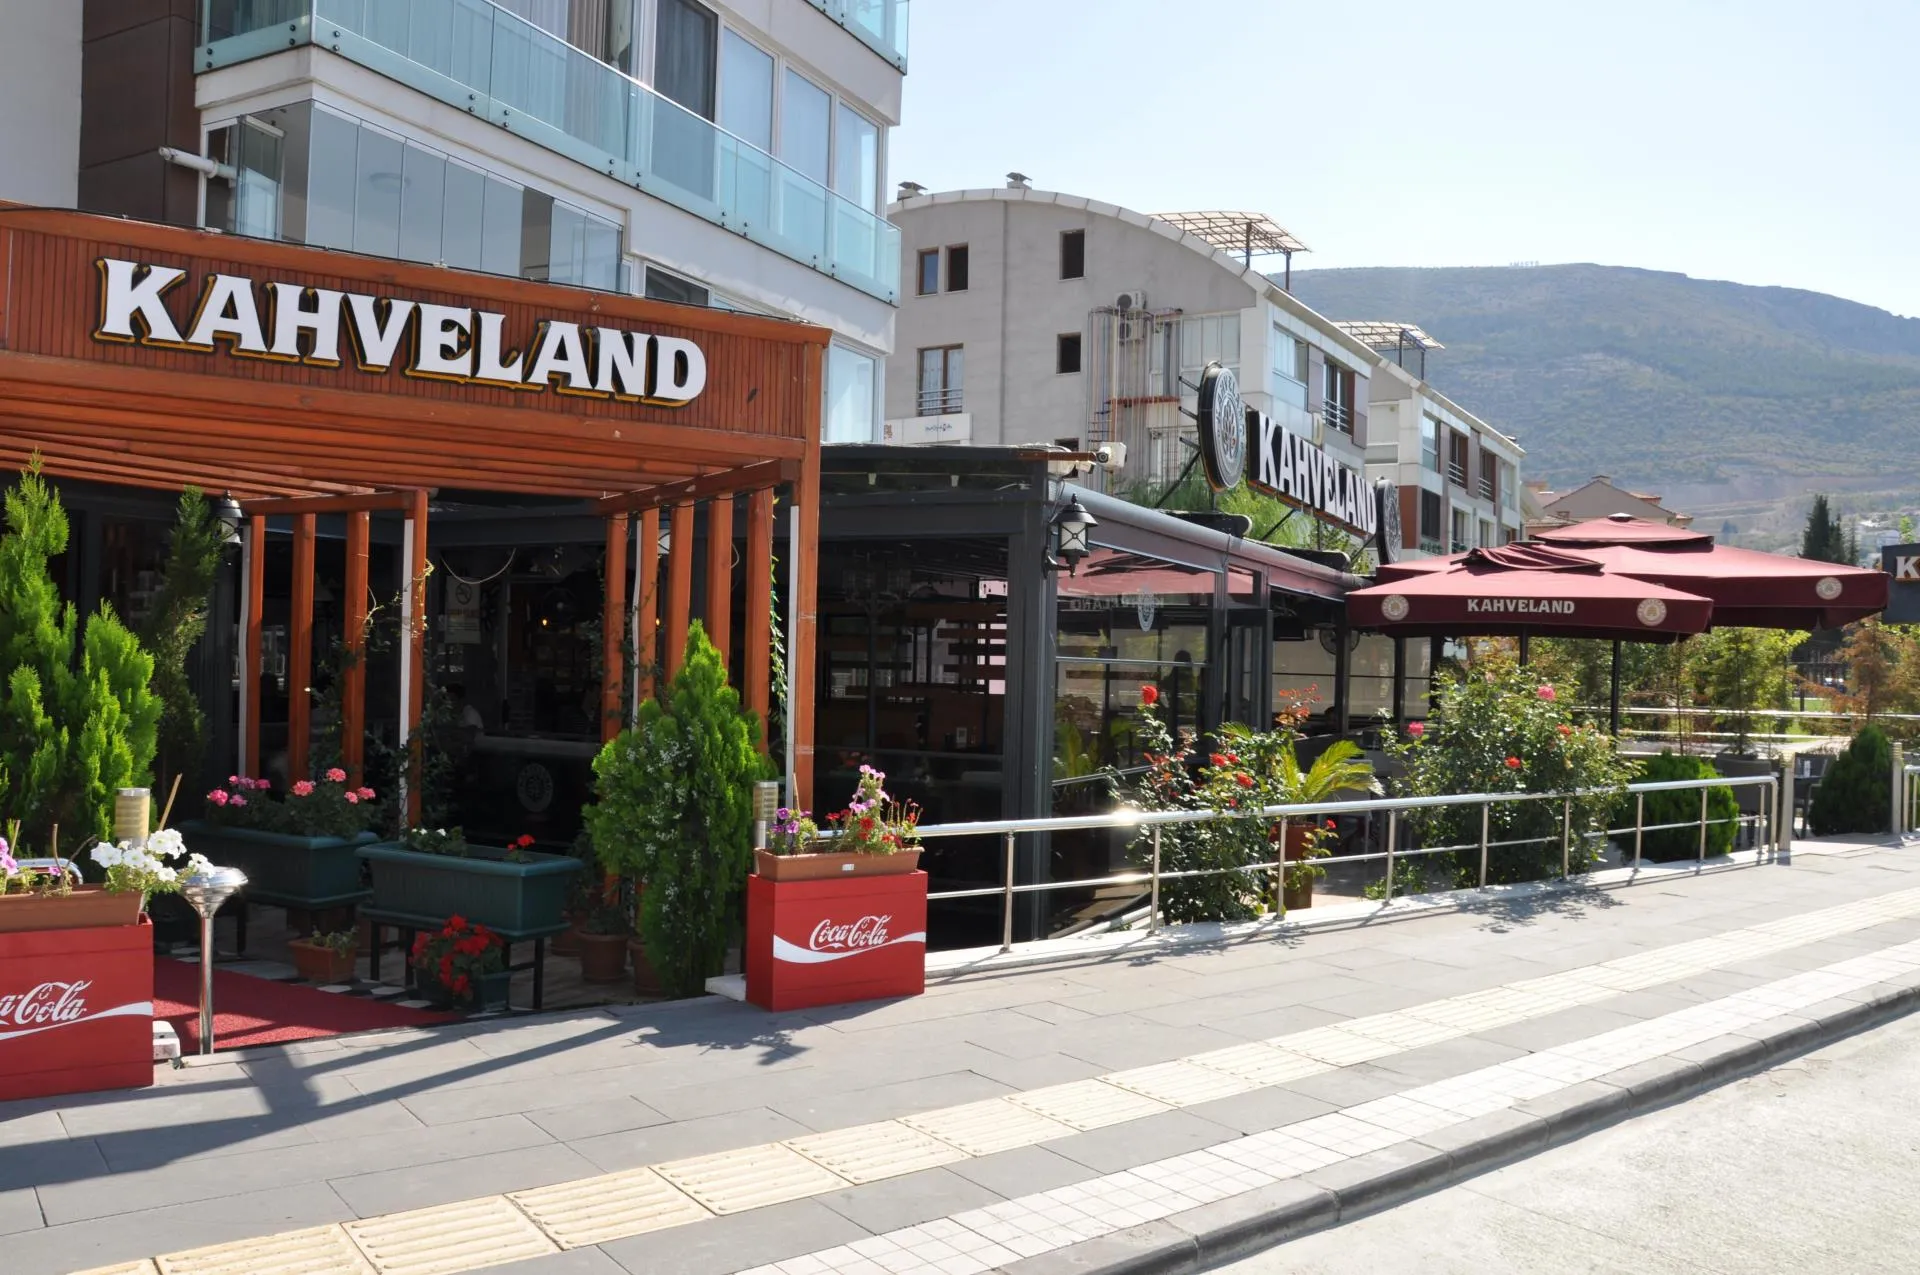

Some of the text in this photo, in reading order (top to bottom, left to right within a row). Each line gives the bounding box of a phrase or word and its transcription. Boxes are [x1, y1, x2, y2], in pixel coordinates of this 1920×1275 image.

[94, 257, 709, 407] KAHVELAND
[1257, 411, 1378, 535] KAHVELAND
[1467, 598, 1576, 615] KAHVELAND
[809, 914, 893, 951] Coca-Cola
